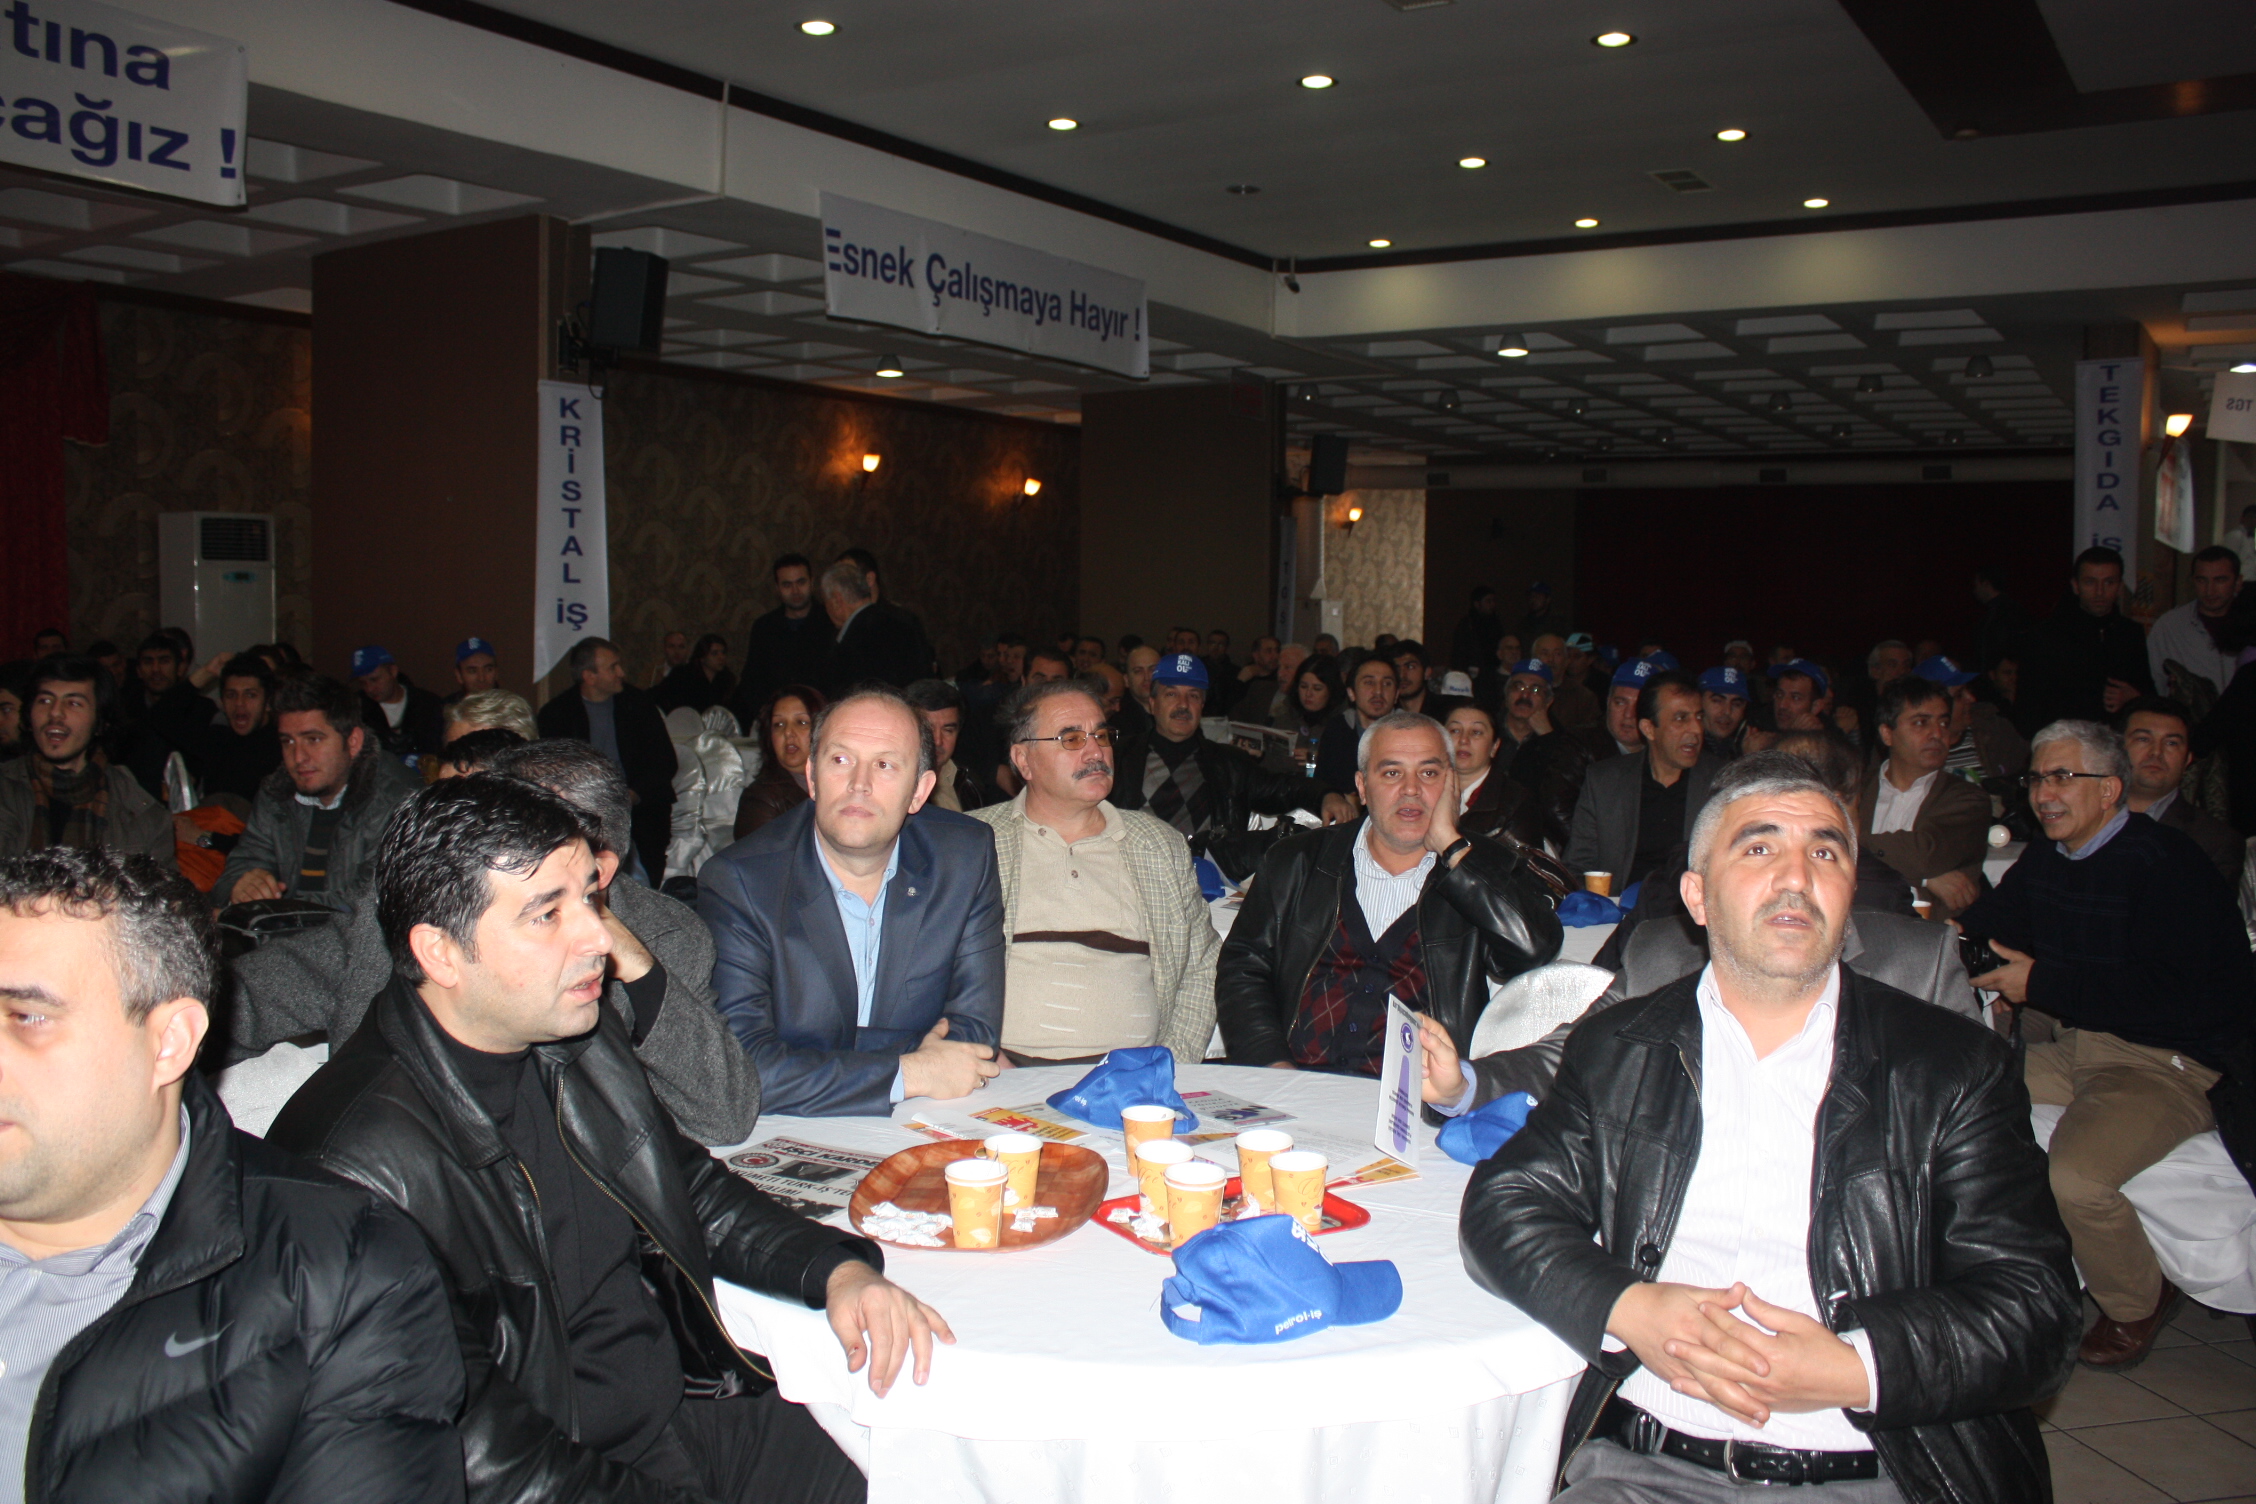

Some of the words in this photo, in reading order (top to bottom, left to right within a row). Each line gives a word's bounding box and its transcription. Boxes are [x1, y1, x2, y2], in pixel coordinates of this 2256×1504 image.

[4, 0, 170, 90] tına
[0, 92, 191, 172] ağız
[825, 227, 914, 288] Esnek
[926, 253, 1062, 326] Çalışmaya
[1070, 289, 1129, 342] Hayır
[2096, 364, 2122, 512] TEKGIDA
[559, 398, 583, 584] KRİSTAL
[556, 598, 588, 631] İŞ
